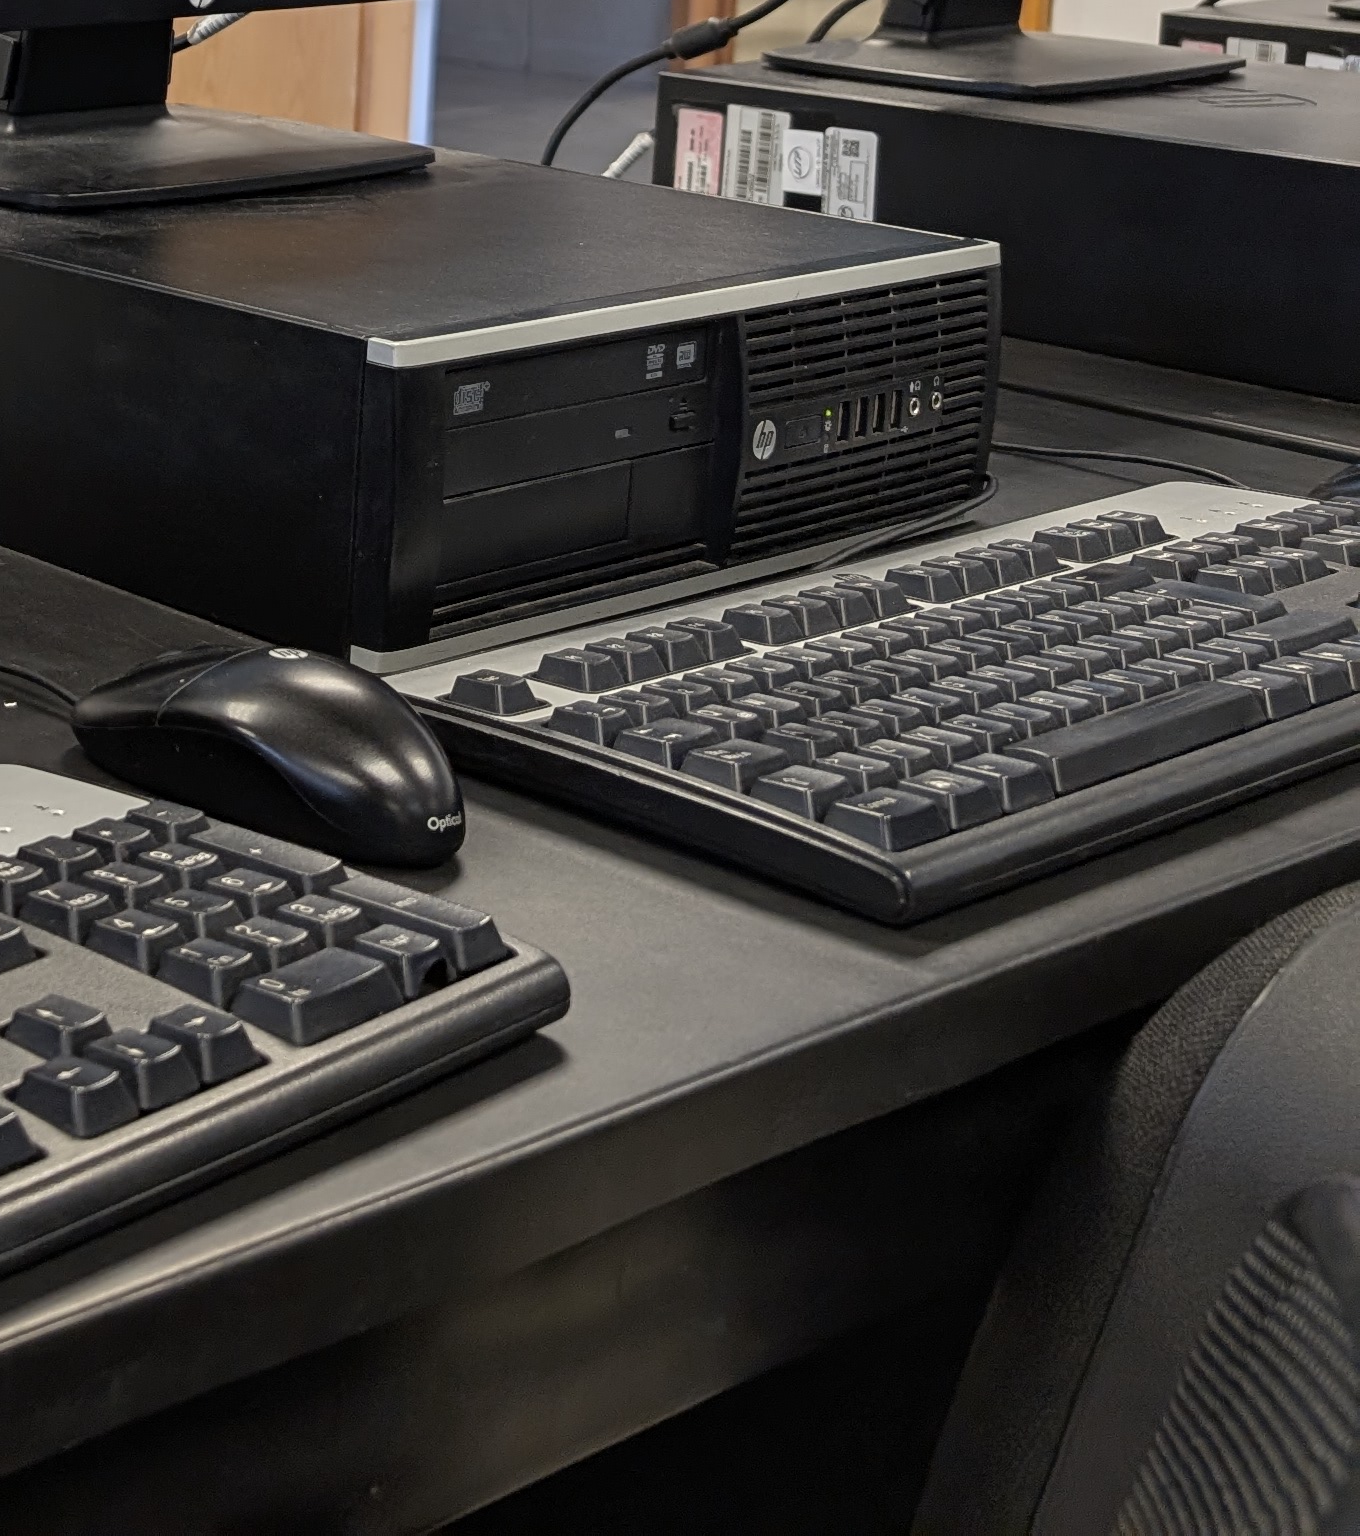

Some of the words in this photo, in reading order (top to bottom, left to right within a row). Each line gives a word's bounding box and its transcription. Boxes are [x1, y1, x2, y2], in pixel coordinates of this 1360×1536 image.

[646, 343, 666, 355] DVD
[754, 420, 776, 459] hp
[426, 811, 463, 833] Optical
